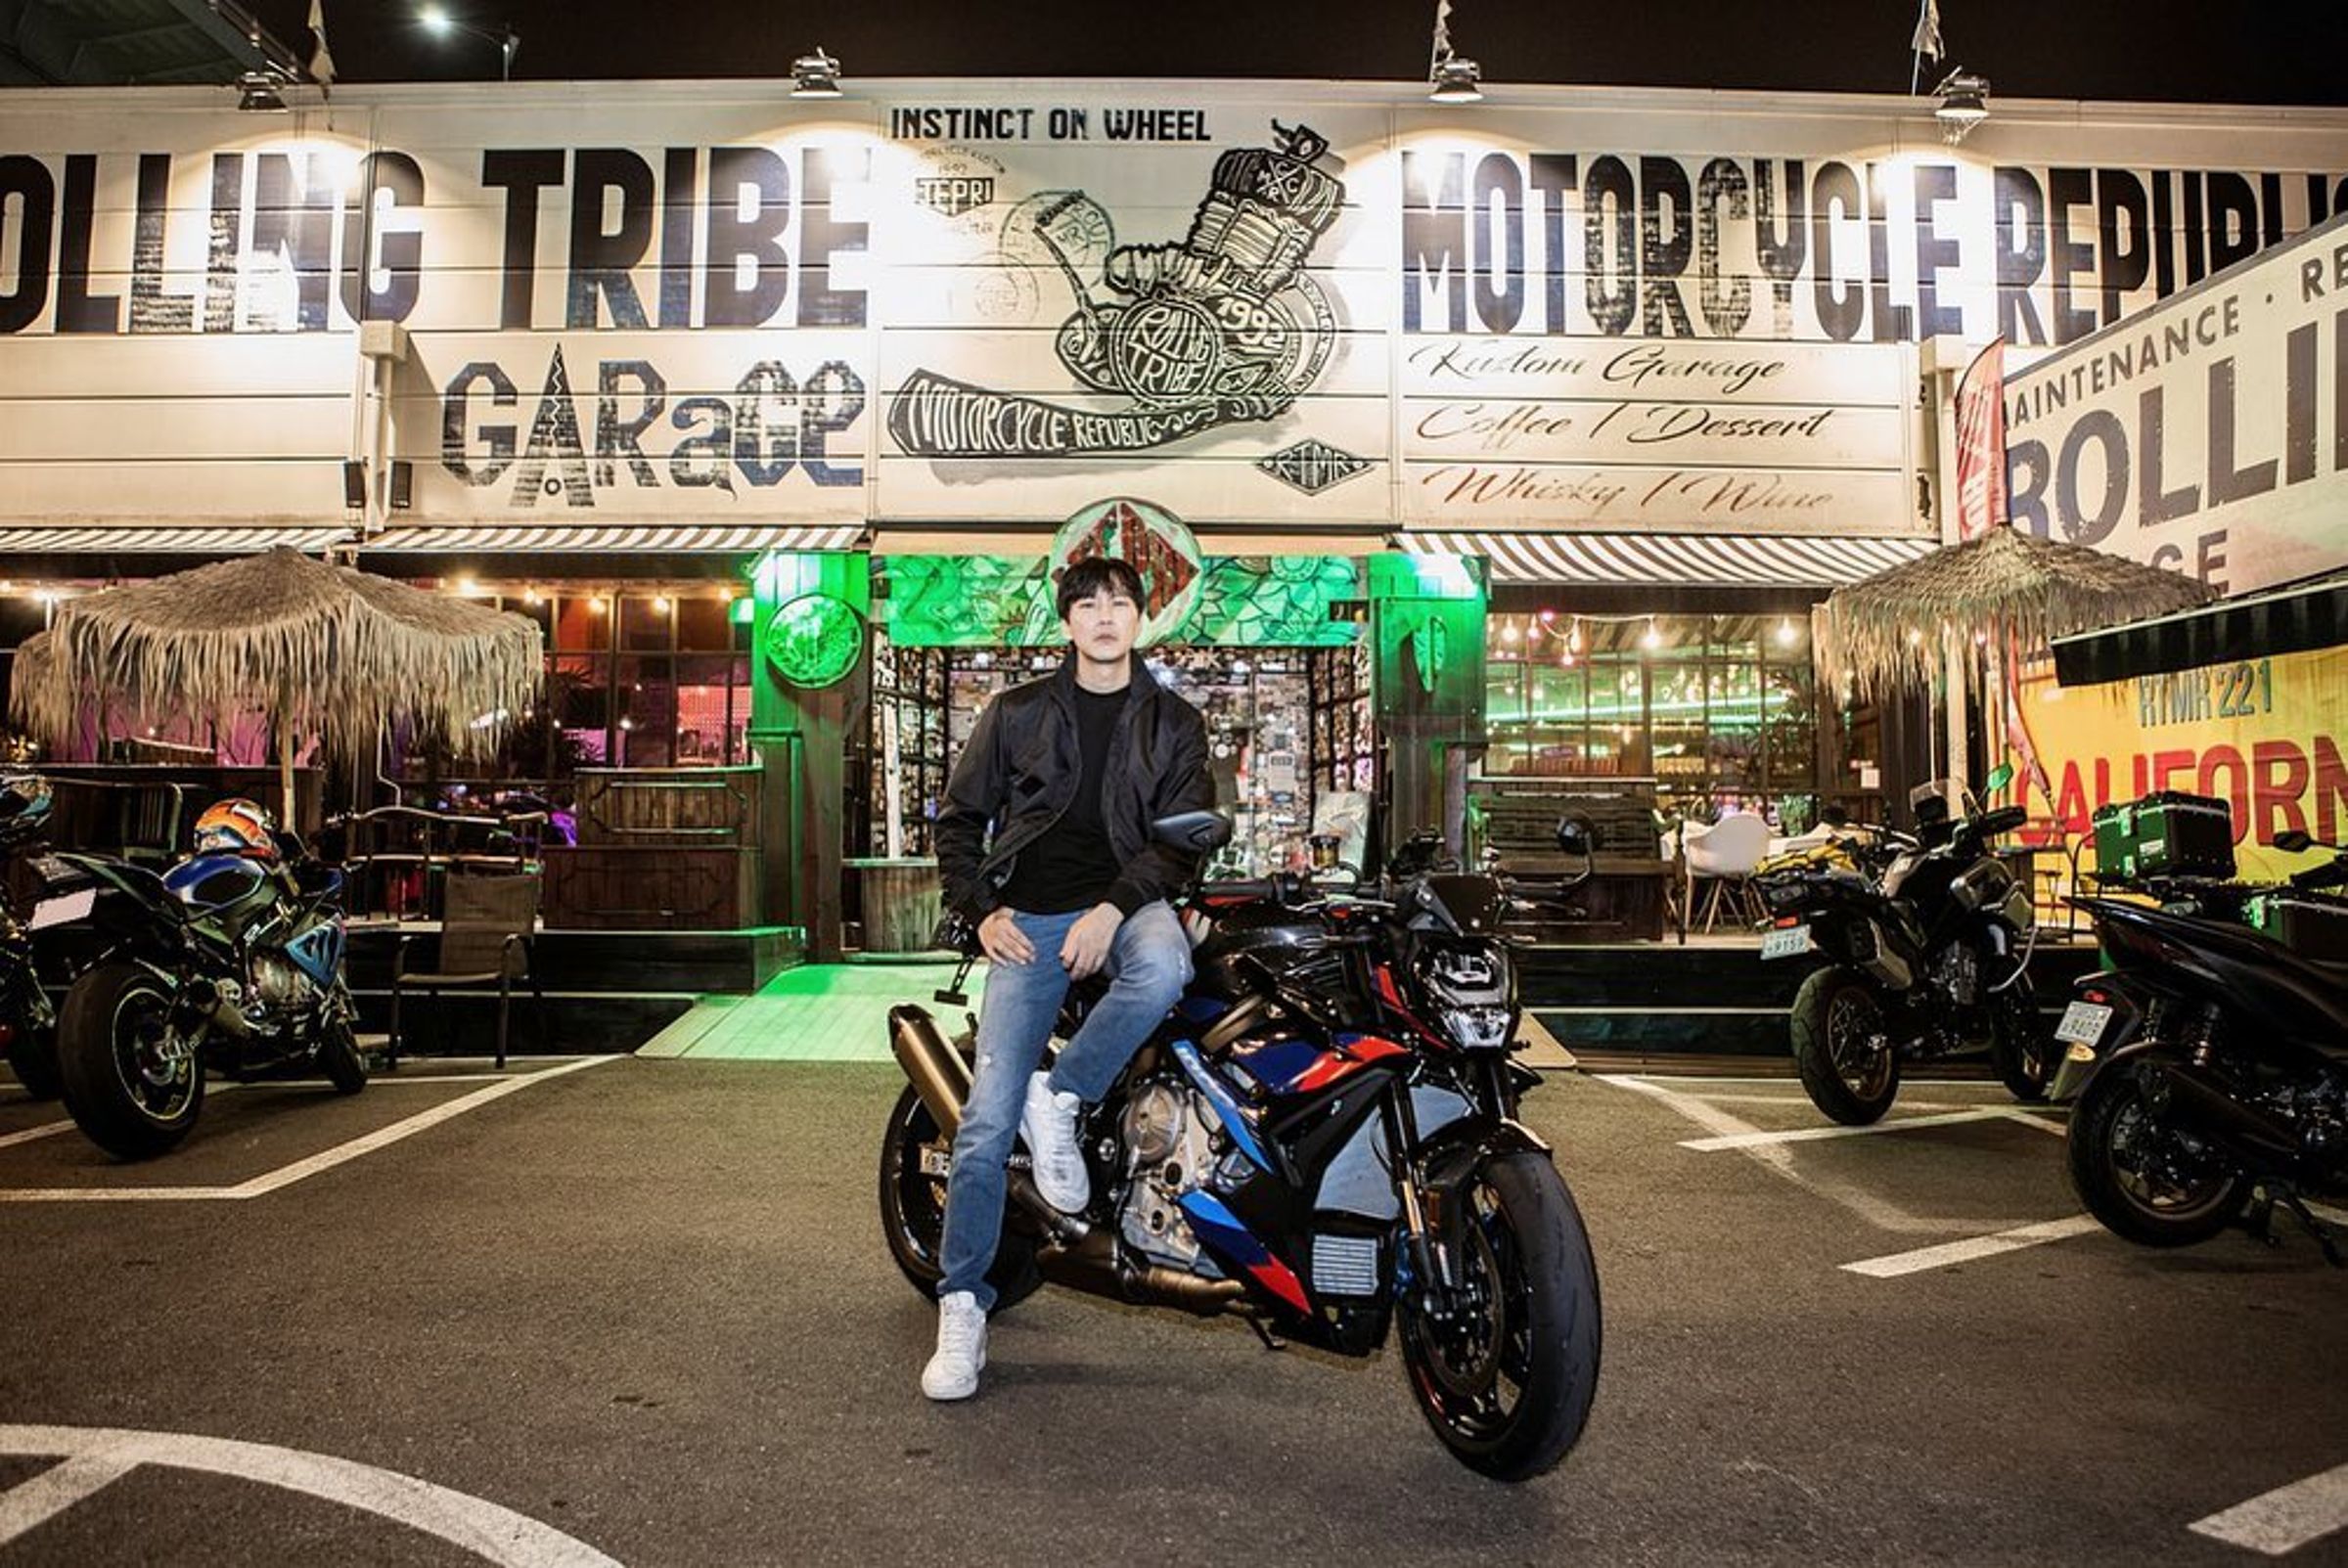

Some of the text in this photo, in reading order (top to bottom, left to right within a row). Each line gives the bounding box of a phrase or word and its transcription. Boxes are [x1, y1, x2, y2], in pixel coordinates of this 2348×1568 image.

[891, 108, 1211, 141] INSTINCT ON WHEEL
[481, 147, 868, 329] TRIBE
[1403, 152, 1964, 341] MOTORCYCLE
[1128, 340, 1208, 392] TRIBE
[1603, 344, 1784, 393] Garage
[2003, 294, 2239, 431] AINTENANCE
[908, 378, 1162, 450] MOTORCYCLE REPUBLIC
[1418, 402, 1572, 450] Coffee
[1627, 406, 1833, 443] Dessert
[2007, 306, 2348, 548] ROLLI
[1422, 467, 1626, 516] Whisky
[2216, 659, 2272, 719] 221
